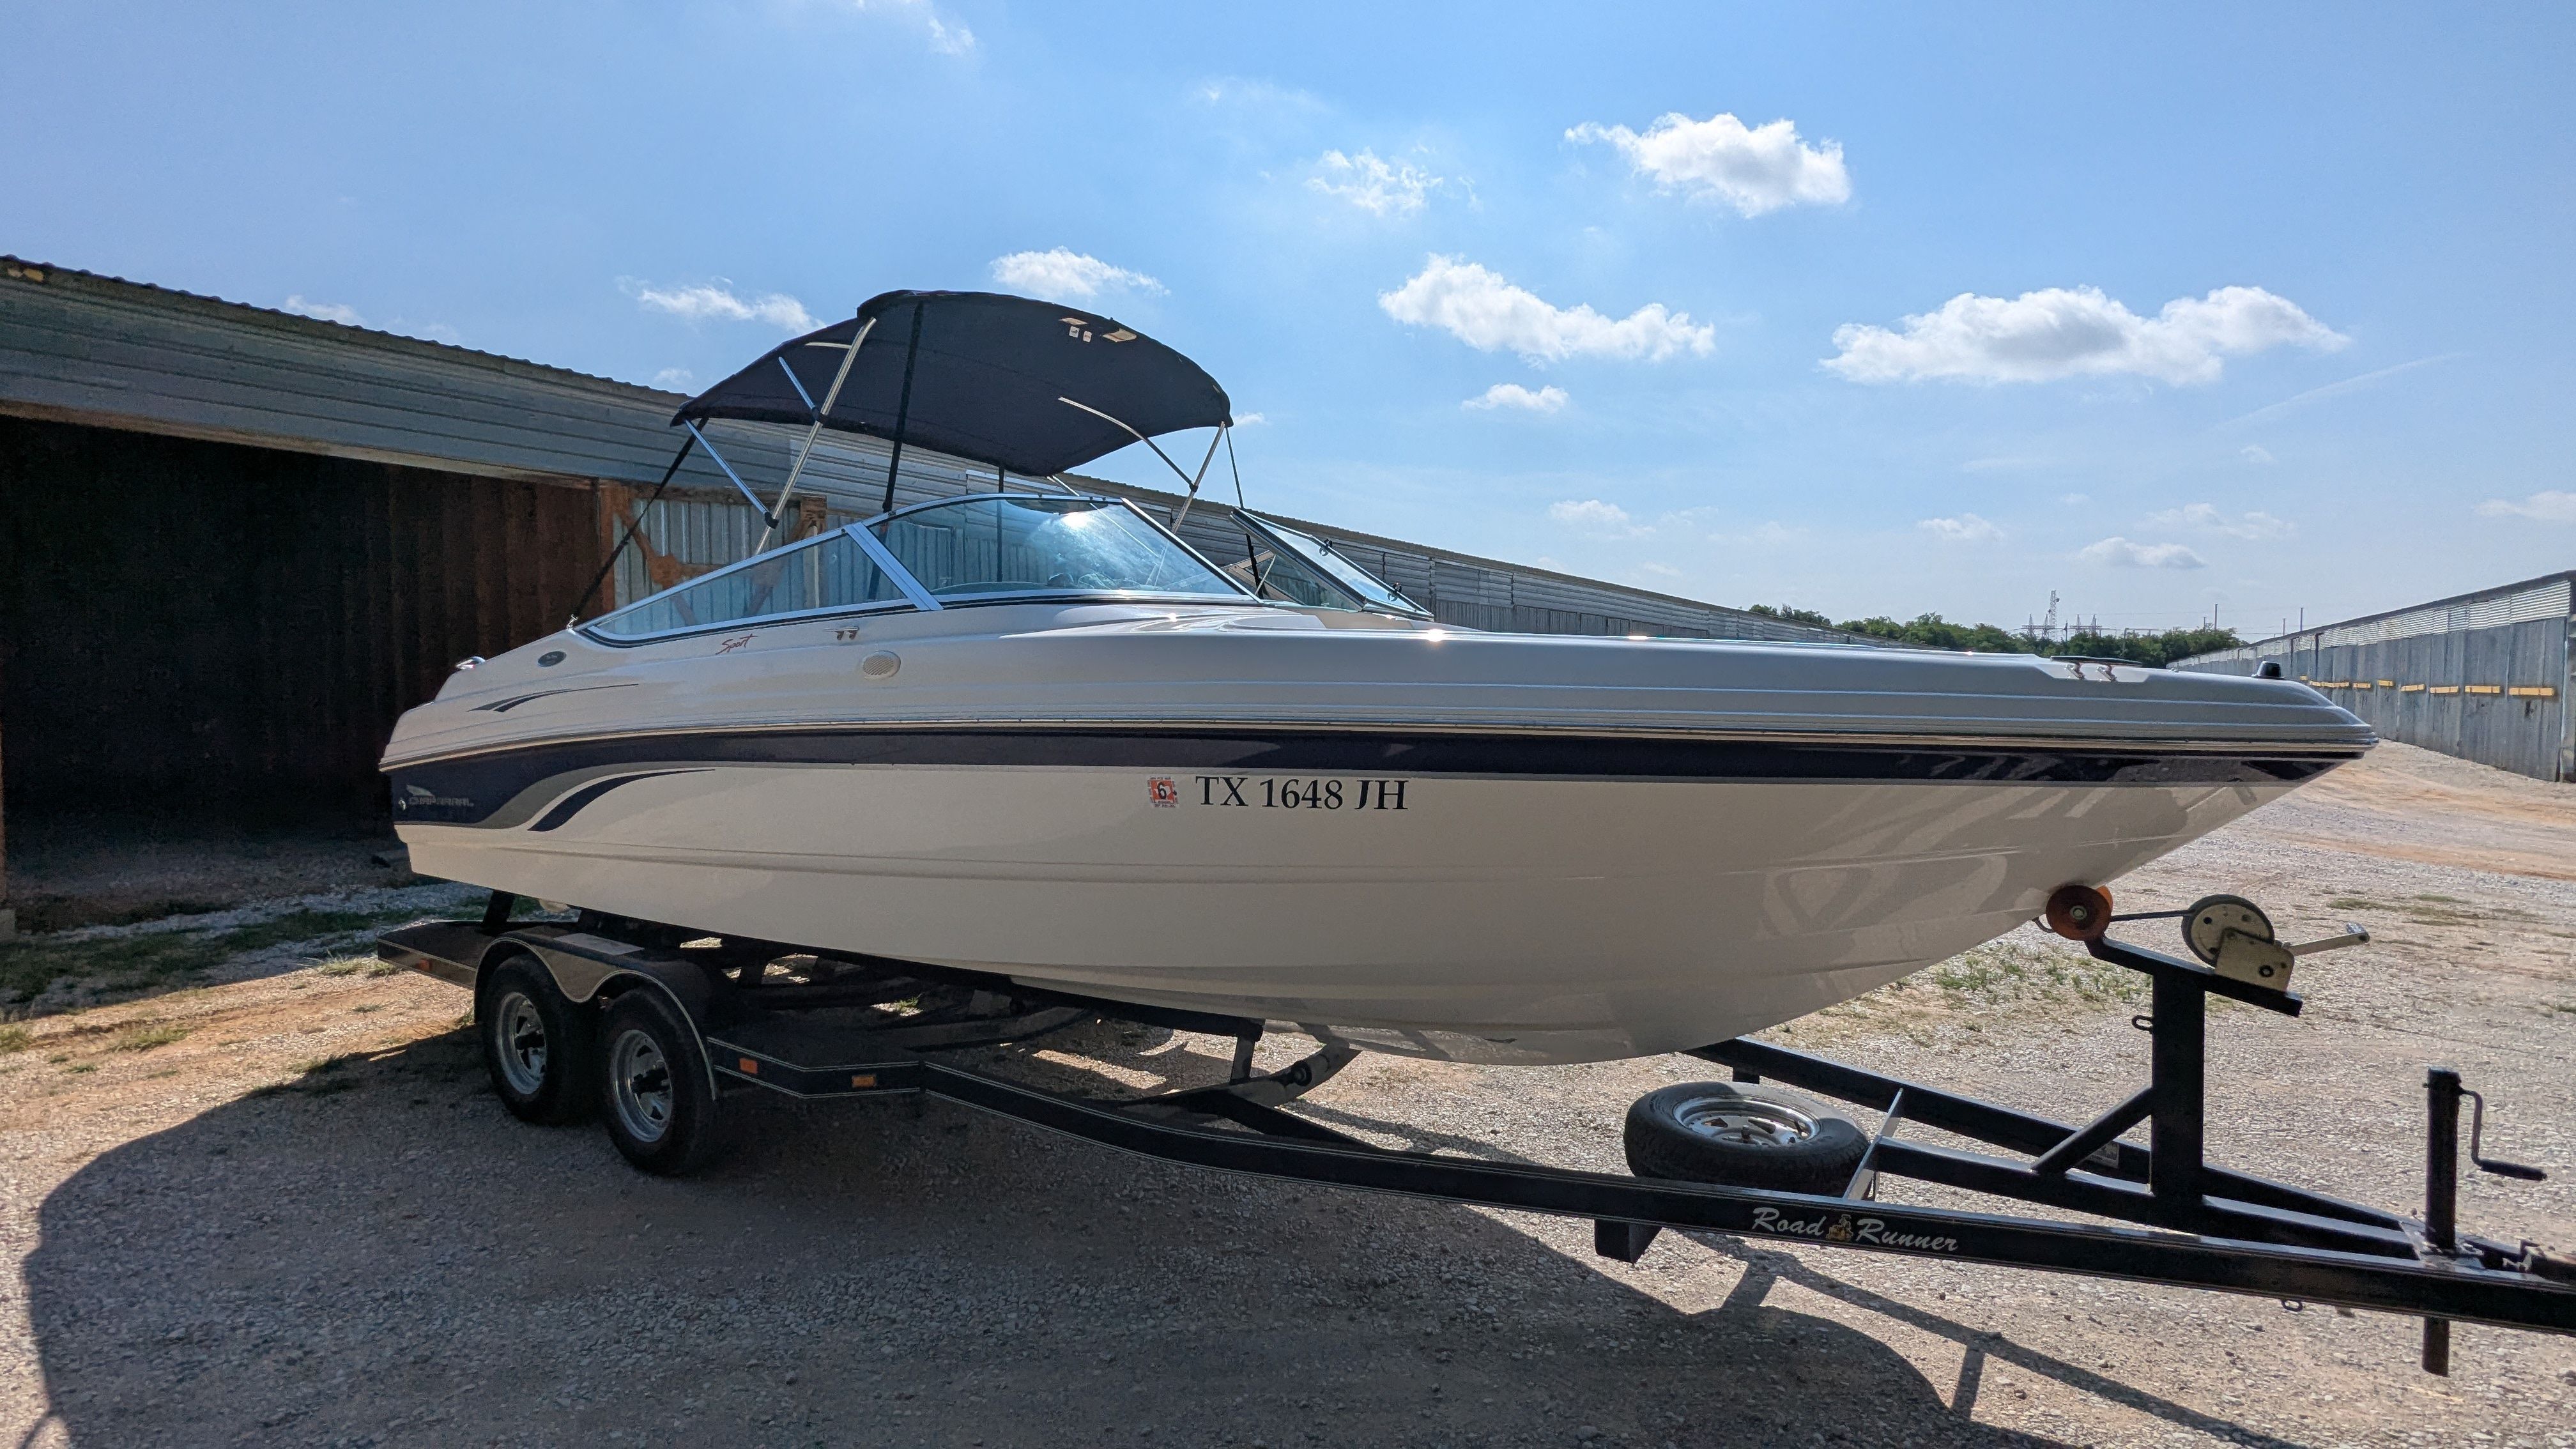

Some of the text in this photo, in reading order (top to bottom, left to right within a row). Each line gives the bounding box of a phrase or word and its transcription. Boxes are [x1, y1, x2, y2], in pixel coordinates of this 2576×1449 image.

[715, 633, 761, 656] Sport
[1157, 781, 1167, 800] 6
[1195, 776, 1409, 810] TX 1648 JH
[1751, 1206, 1958, 1252] Road Runner
